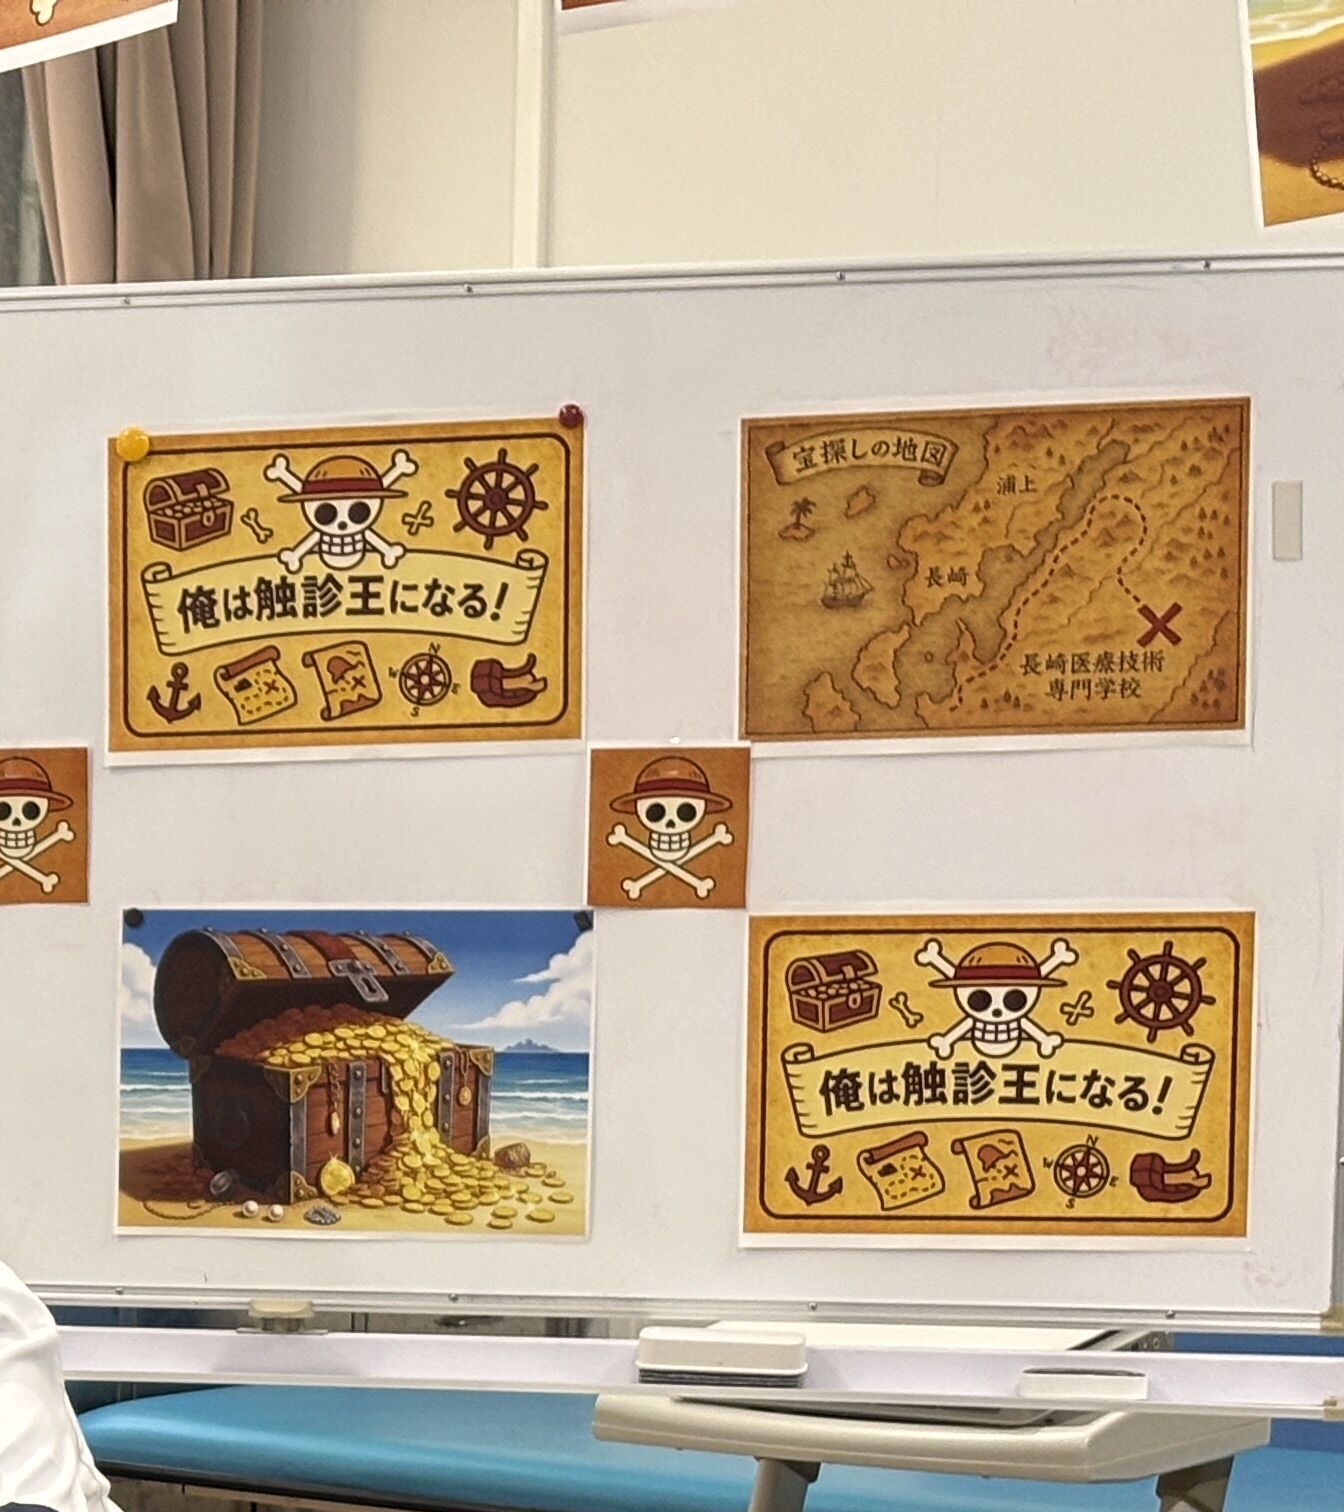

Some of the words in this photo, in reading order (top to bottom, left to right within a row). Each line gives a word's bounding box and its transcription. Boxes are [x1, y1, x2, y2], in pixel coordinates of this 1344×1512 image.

[792, 436, 949, 473] 宝探しの地図
[996, 474, 1038, 496] 浦上
[924, 566, 968, 588] 長崎
[177, 573, 510, 634] 俺は触診王になる!
[429, 642, 441, 654] N
[1020, 650, 1165, 676] 長崎医療技術
[388, 666, 400, 679] W
[452, 683, 461, 695] E
[1047, 677, 1142, 701] 専門学校
[411, 706, 420, 717] S
[819, 1060, 1173, 1116] 俺は触診王になる!
[1086, 1134, 1099, 1147] N
[1042, 1157, 1054, 1169] W
[1110, 1176, 1119, 1188] E
[1066, 1196, 1075, 1209] S
